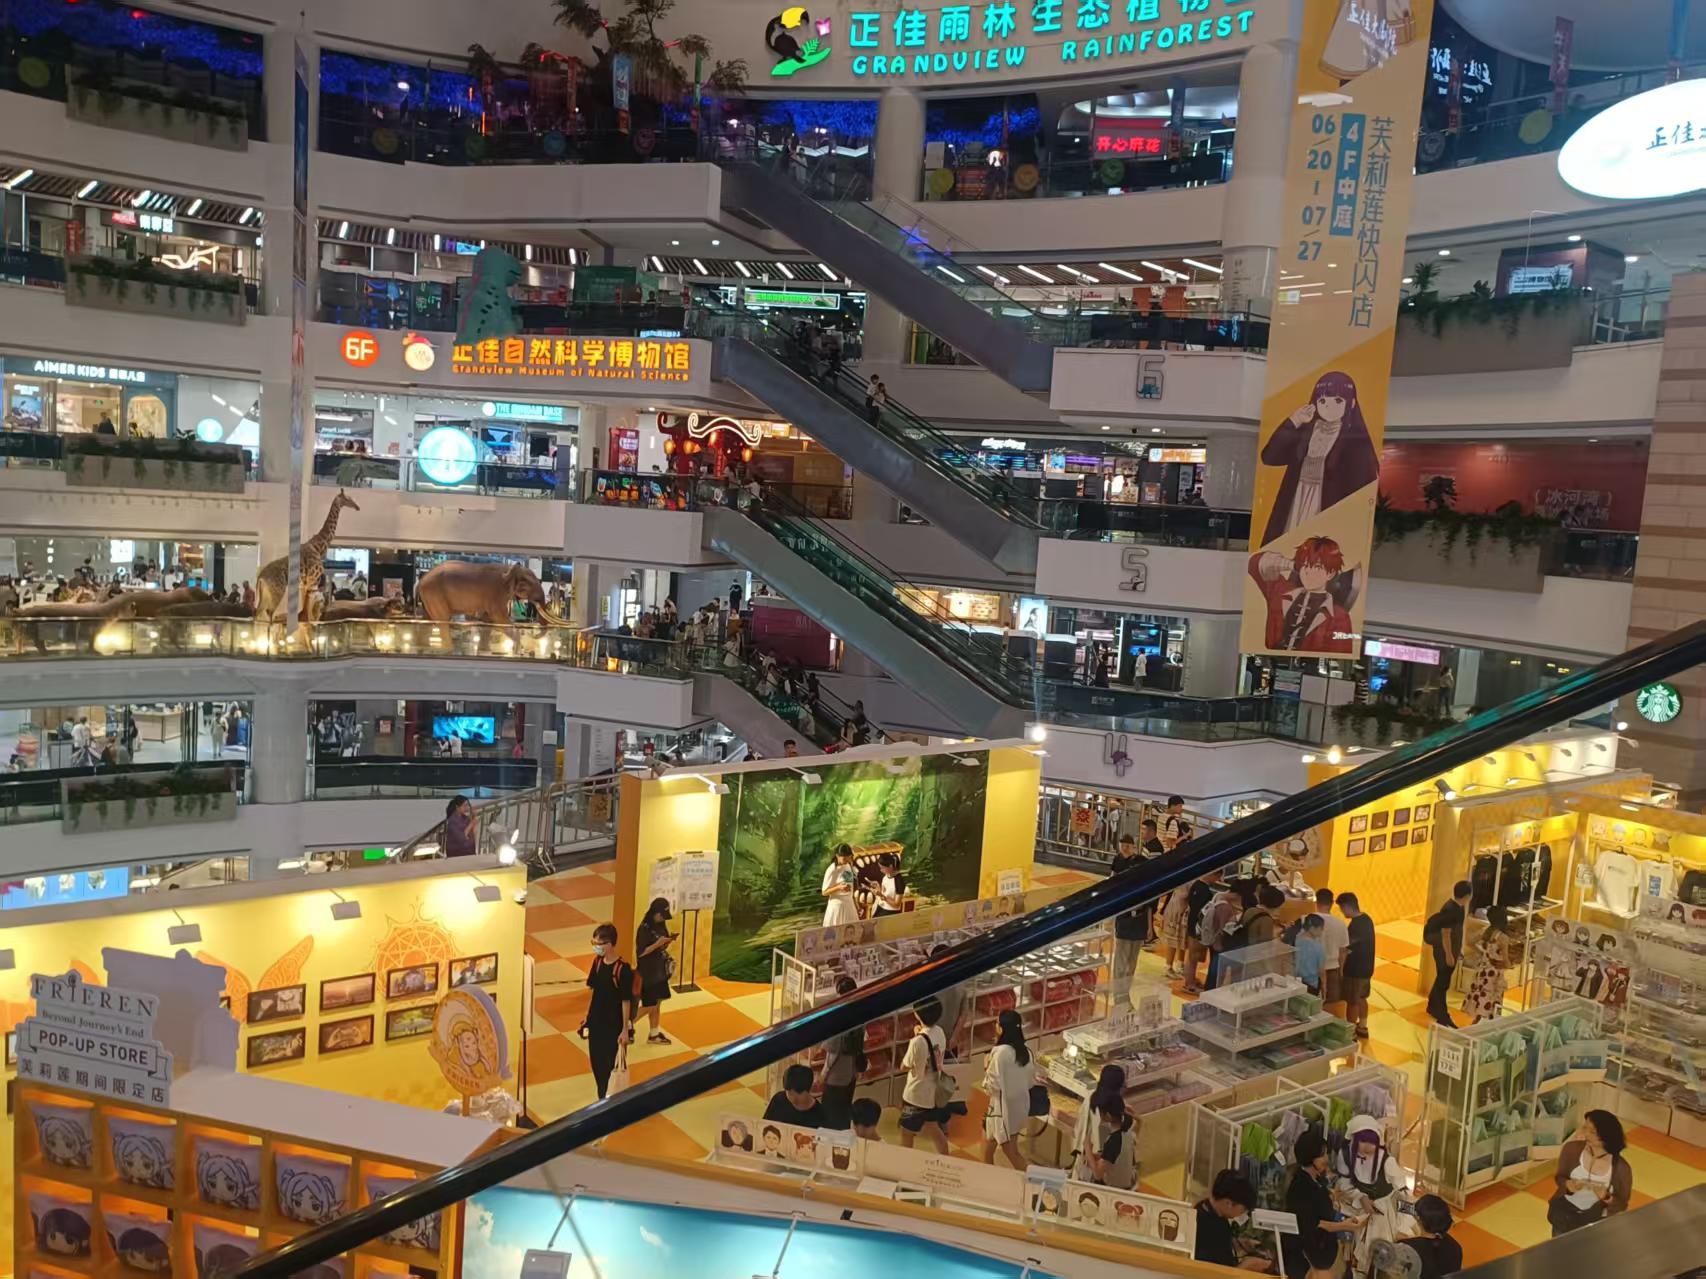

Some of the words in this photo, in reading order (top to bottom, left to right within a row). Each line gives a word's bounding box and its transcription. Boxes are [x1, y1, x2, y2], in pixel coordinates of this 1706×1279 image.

[850, 0, 1242, 47] 正佳雨林生态植
[852, 46, 1026, 75] GRANDVIEW
[1062, 11, 1255, 61] RAINFOREST
[1332, 121, 1359, 230] 4F中庭
[1348, 116, 1394, 329] 芙莉莲快闪店
[345, 337, 375, 361] 6F
[453, 338, 690, 370] 正佳自然科学博物馆
[453, 364, 513, 375] Grandview
[519, 366, 565, 377] Museum
[571, 368, 584, 377] of
[588, 368, 635, 379] Natural
[641, 371, 689, 381] Science
[33, 974, 154, 1018] FRIEREN
[42, 1009, 77, 1025] Beyond
[124, 1025, 145, 1039] End
[39, 1029, 96, 1053] POP-UP
[99, 1042, 150, 1066] STORE
